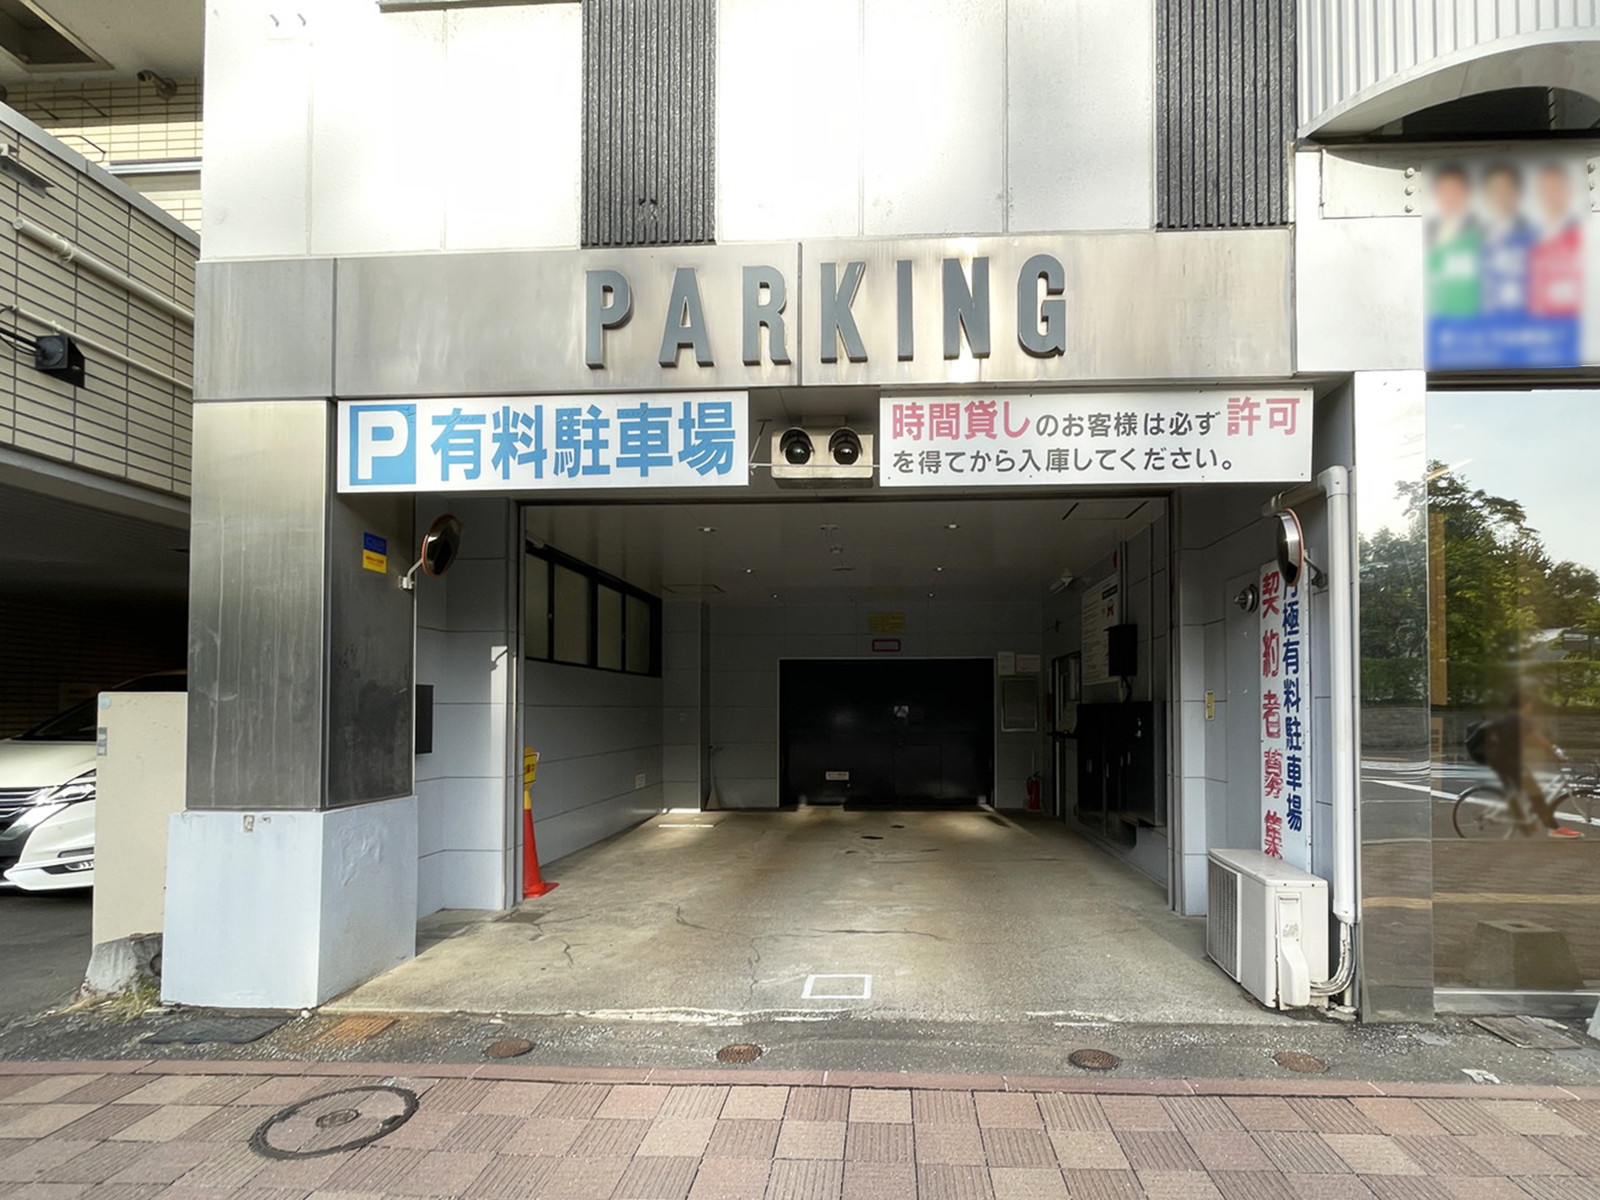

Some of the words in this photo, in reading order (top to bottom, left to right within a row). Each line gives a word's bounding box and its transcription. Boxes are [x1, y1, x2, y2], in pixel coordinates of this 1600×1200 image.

[585, 253, 1066, 369] PARKING
[357, 410, 409, 479] P
[431, 401, 736, 481] 有料駐車場
[892, 447, 1233, 474] を得てから入庫してください。
[1262, 571, 1283, 860] 契約者募集
